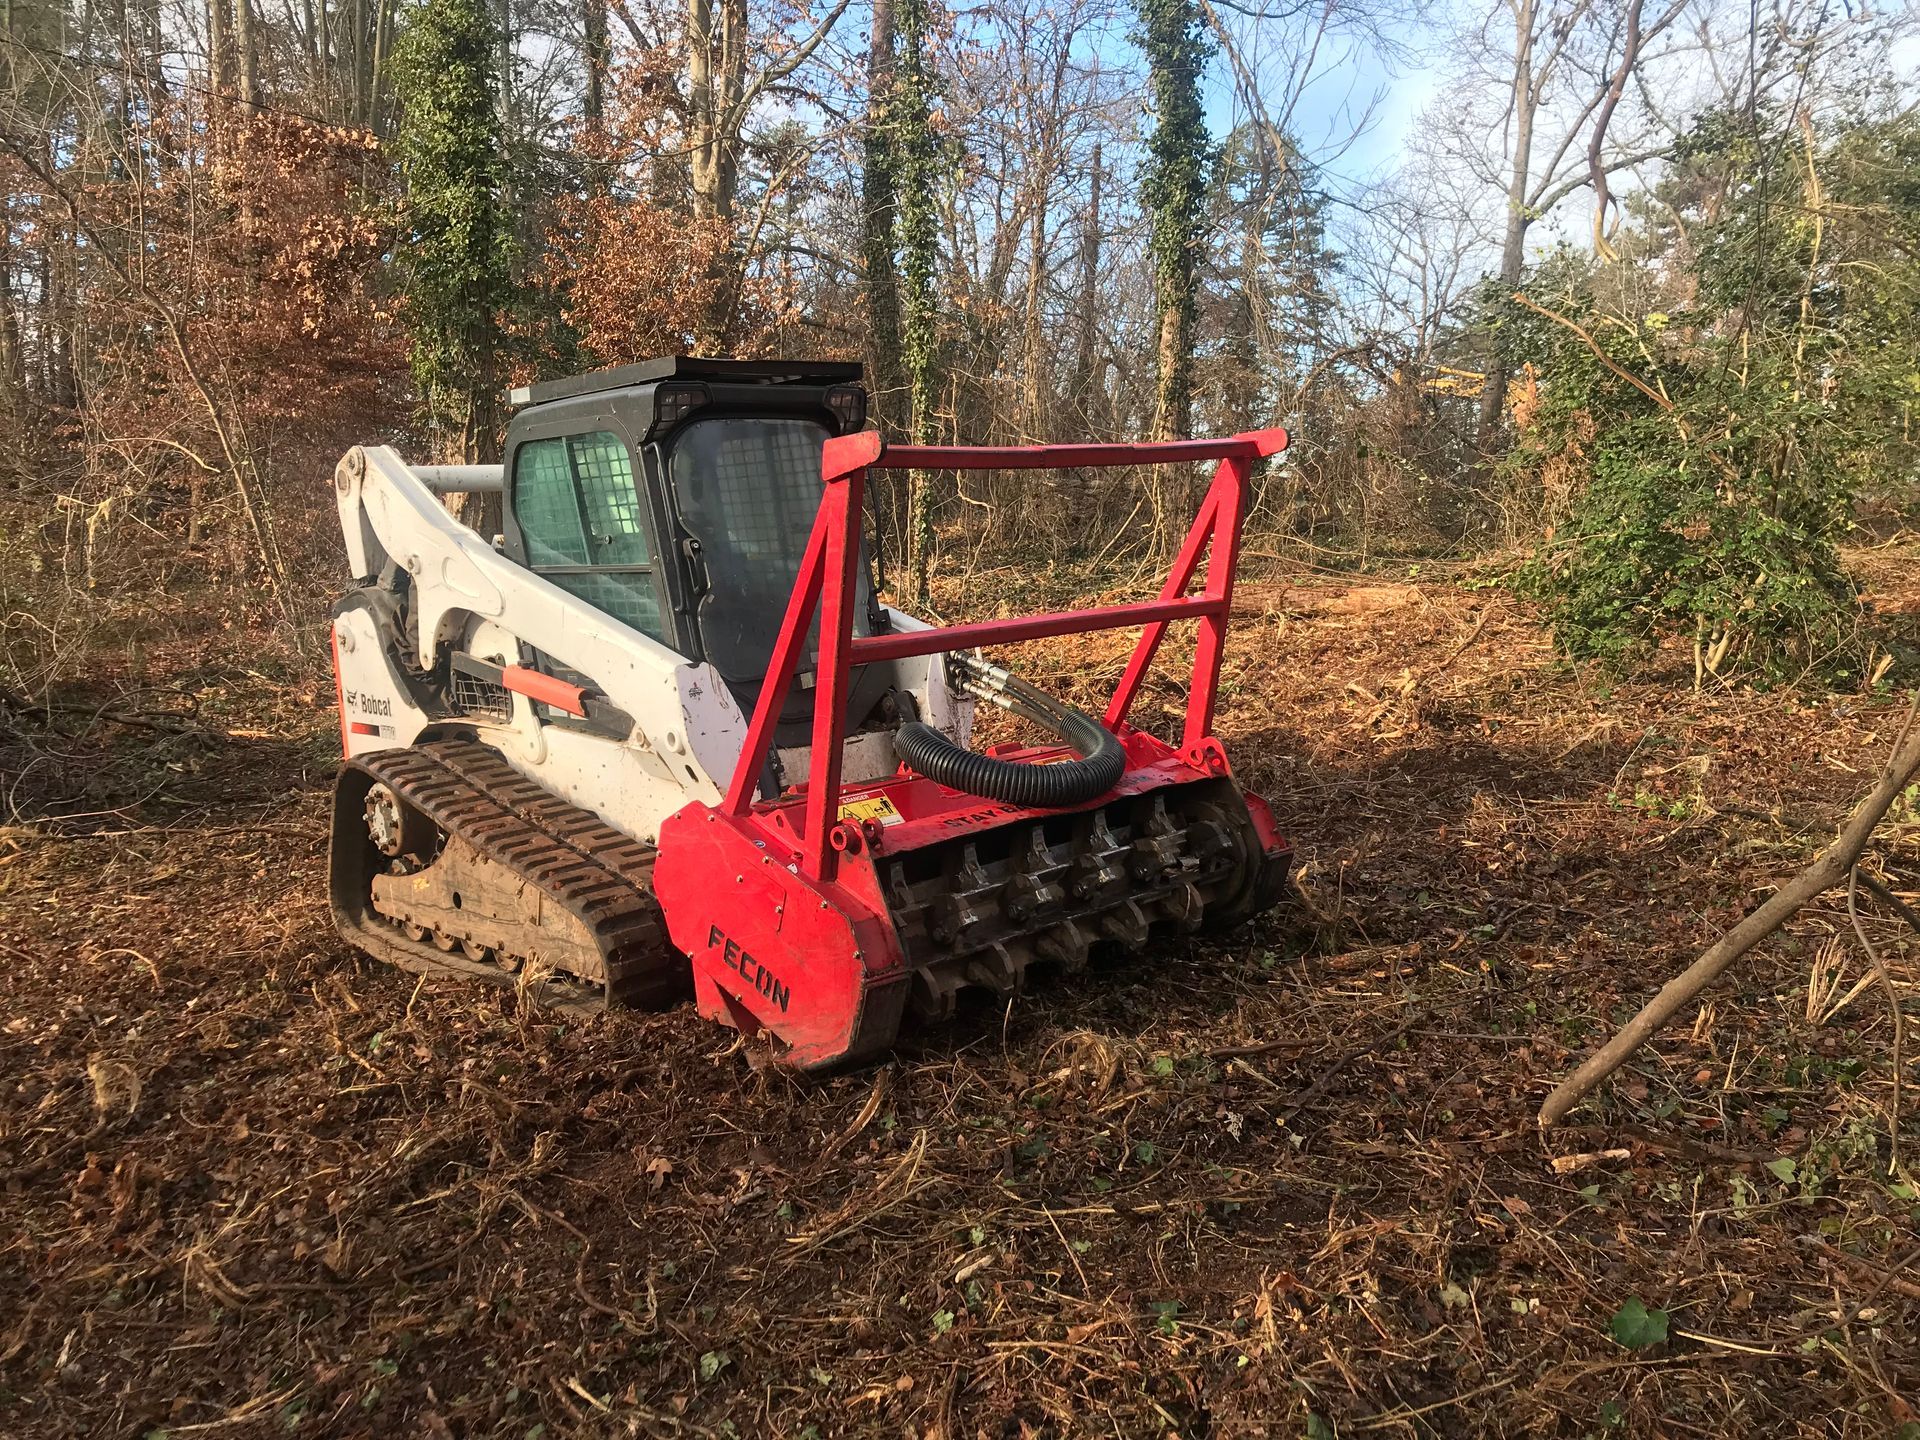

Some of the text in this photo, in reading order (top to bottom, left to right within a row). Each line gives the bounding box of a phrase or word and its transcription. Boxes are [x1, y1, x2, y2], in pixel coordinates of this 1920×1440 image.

[361, 693, 392, 717] Bobcat
[943, 809, 998, 827] STAY
[707, 924, 790, 1013] FECON
